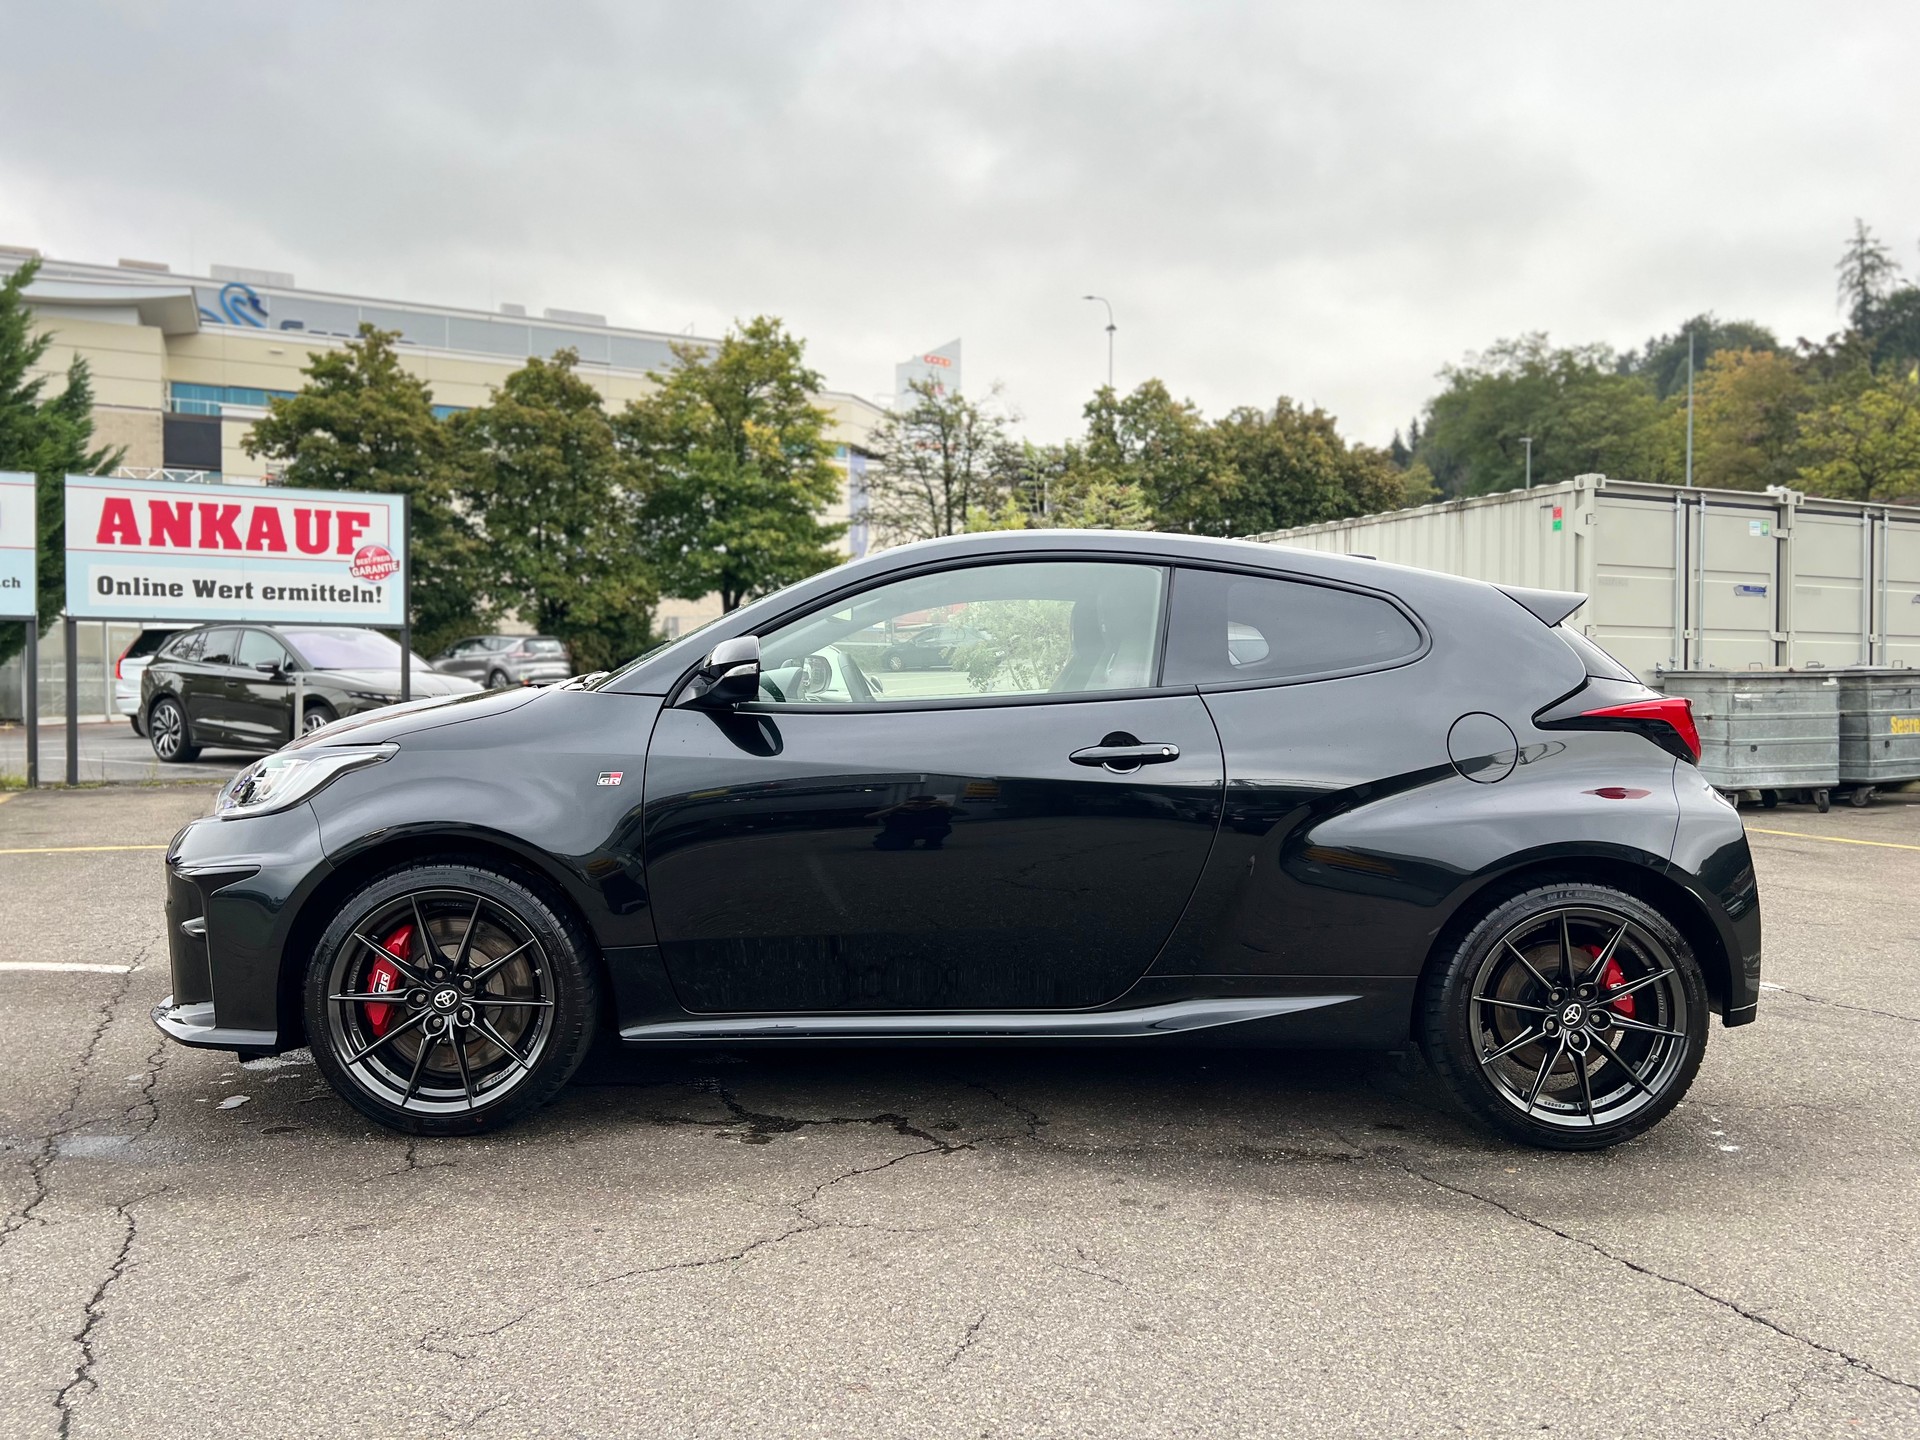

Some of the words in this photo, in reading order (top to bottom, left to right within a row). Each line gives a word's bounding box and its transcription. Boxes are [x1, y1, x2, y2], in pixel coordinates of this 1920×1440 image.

[96, 497, 370, 555] ANKAUF
[352, 561, 398, 577] GARANTIE
[97, 575, 183, 597] Online
[192, 579, 254, 599] Wert
[262, 583, 382, 603] ermitteln!
